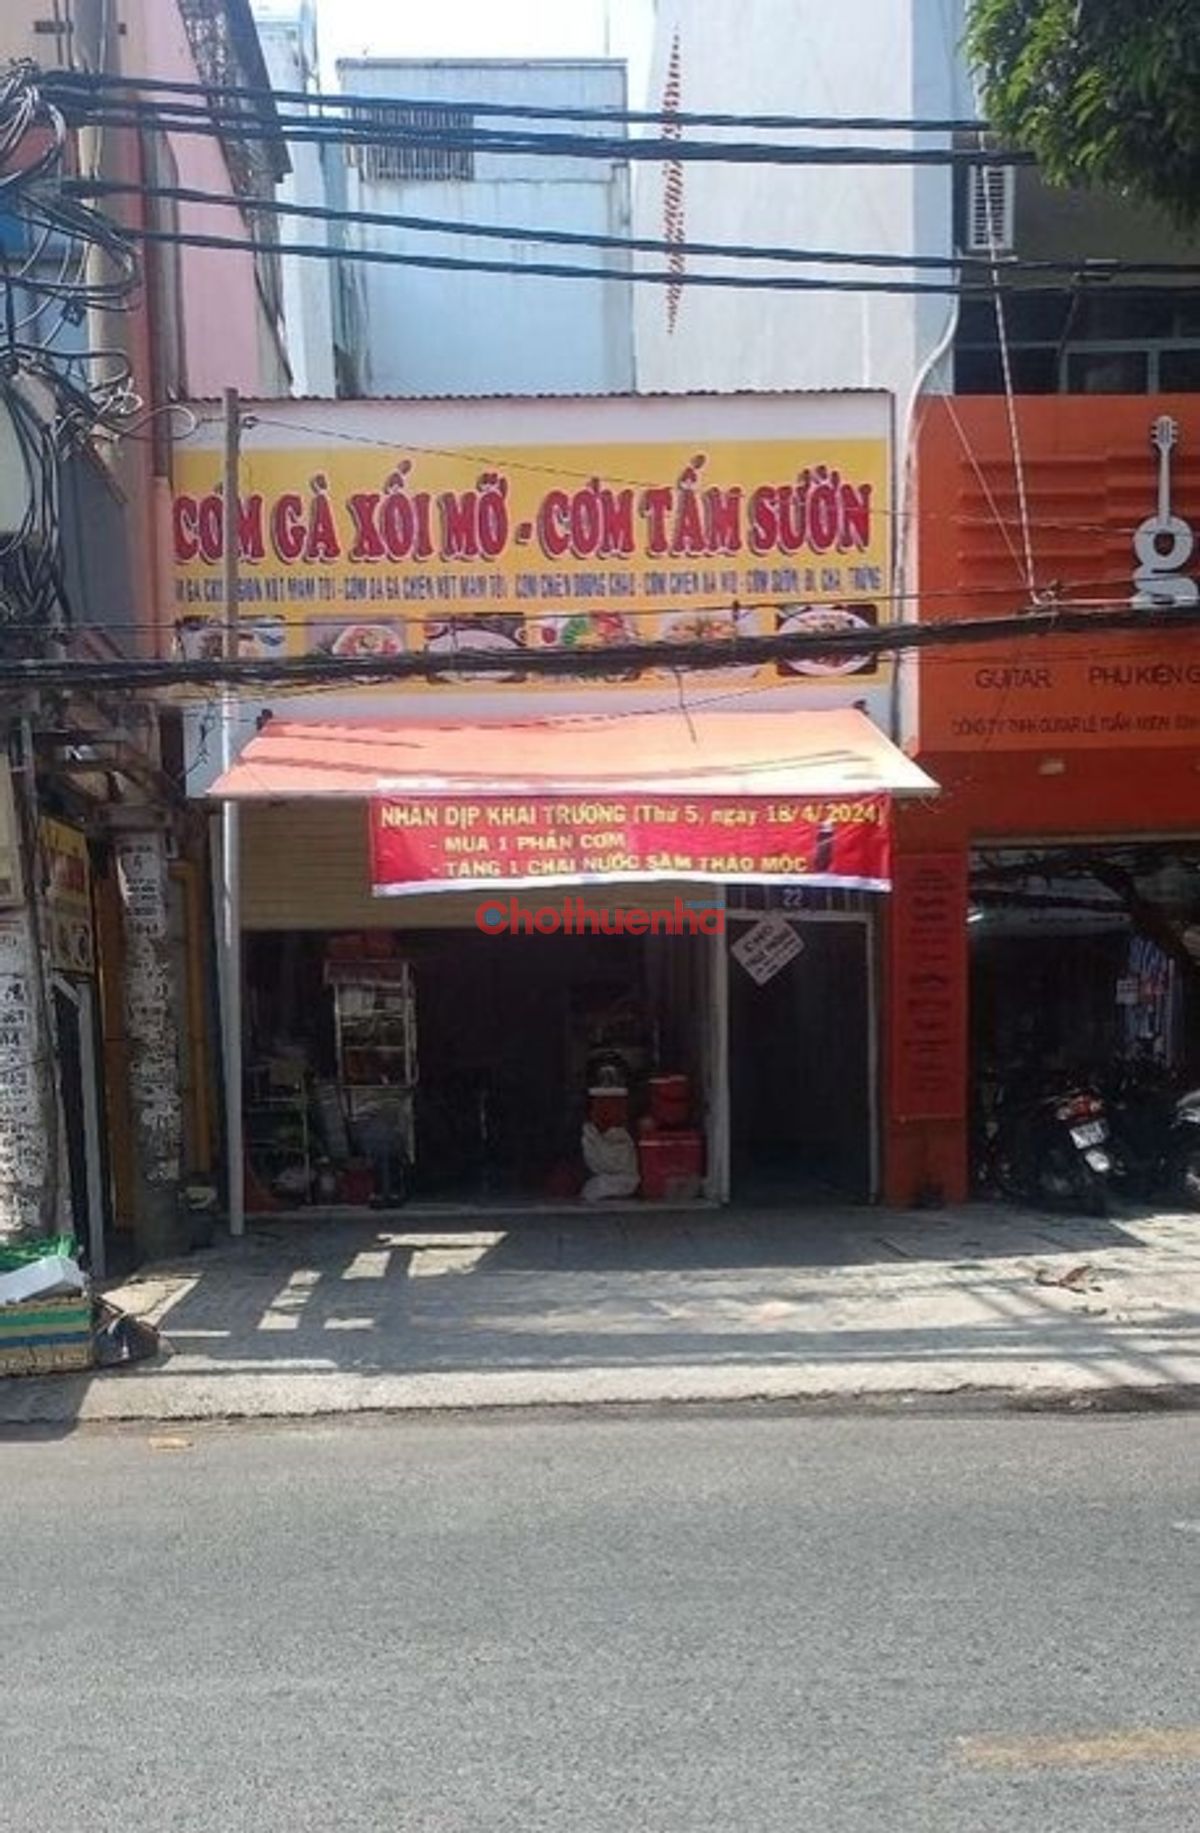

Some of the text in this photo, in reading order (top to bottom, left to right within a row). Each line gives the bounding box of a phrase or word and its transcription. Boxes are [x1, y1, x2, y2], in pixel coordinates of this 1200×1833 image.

[271, 473, 340, 563] GÀ
[347, 458, 436, 563] XỐI
[437, 472, 508, 563] MỠ
[537, 476, 635, 559] CƠM
[639, 454, 742, 558] TẤM
[749, 464, 872, 556] SƯỜN
[975, 667, 1053, 690] GUITAR
[486, 803, 538, 827] KHAI
[444, 835, 491, 853] MUA
[527, 857, 577, 875] CHAI
